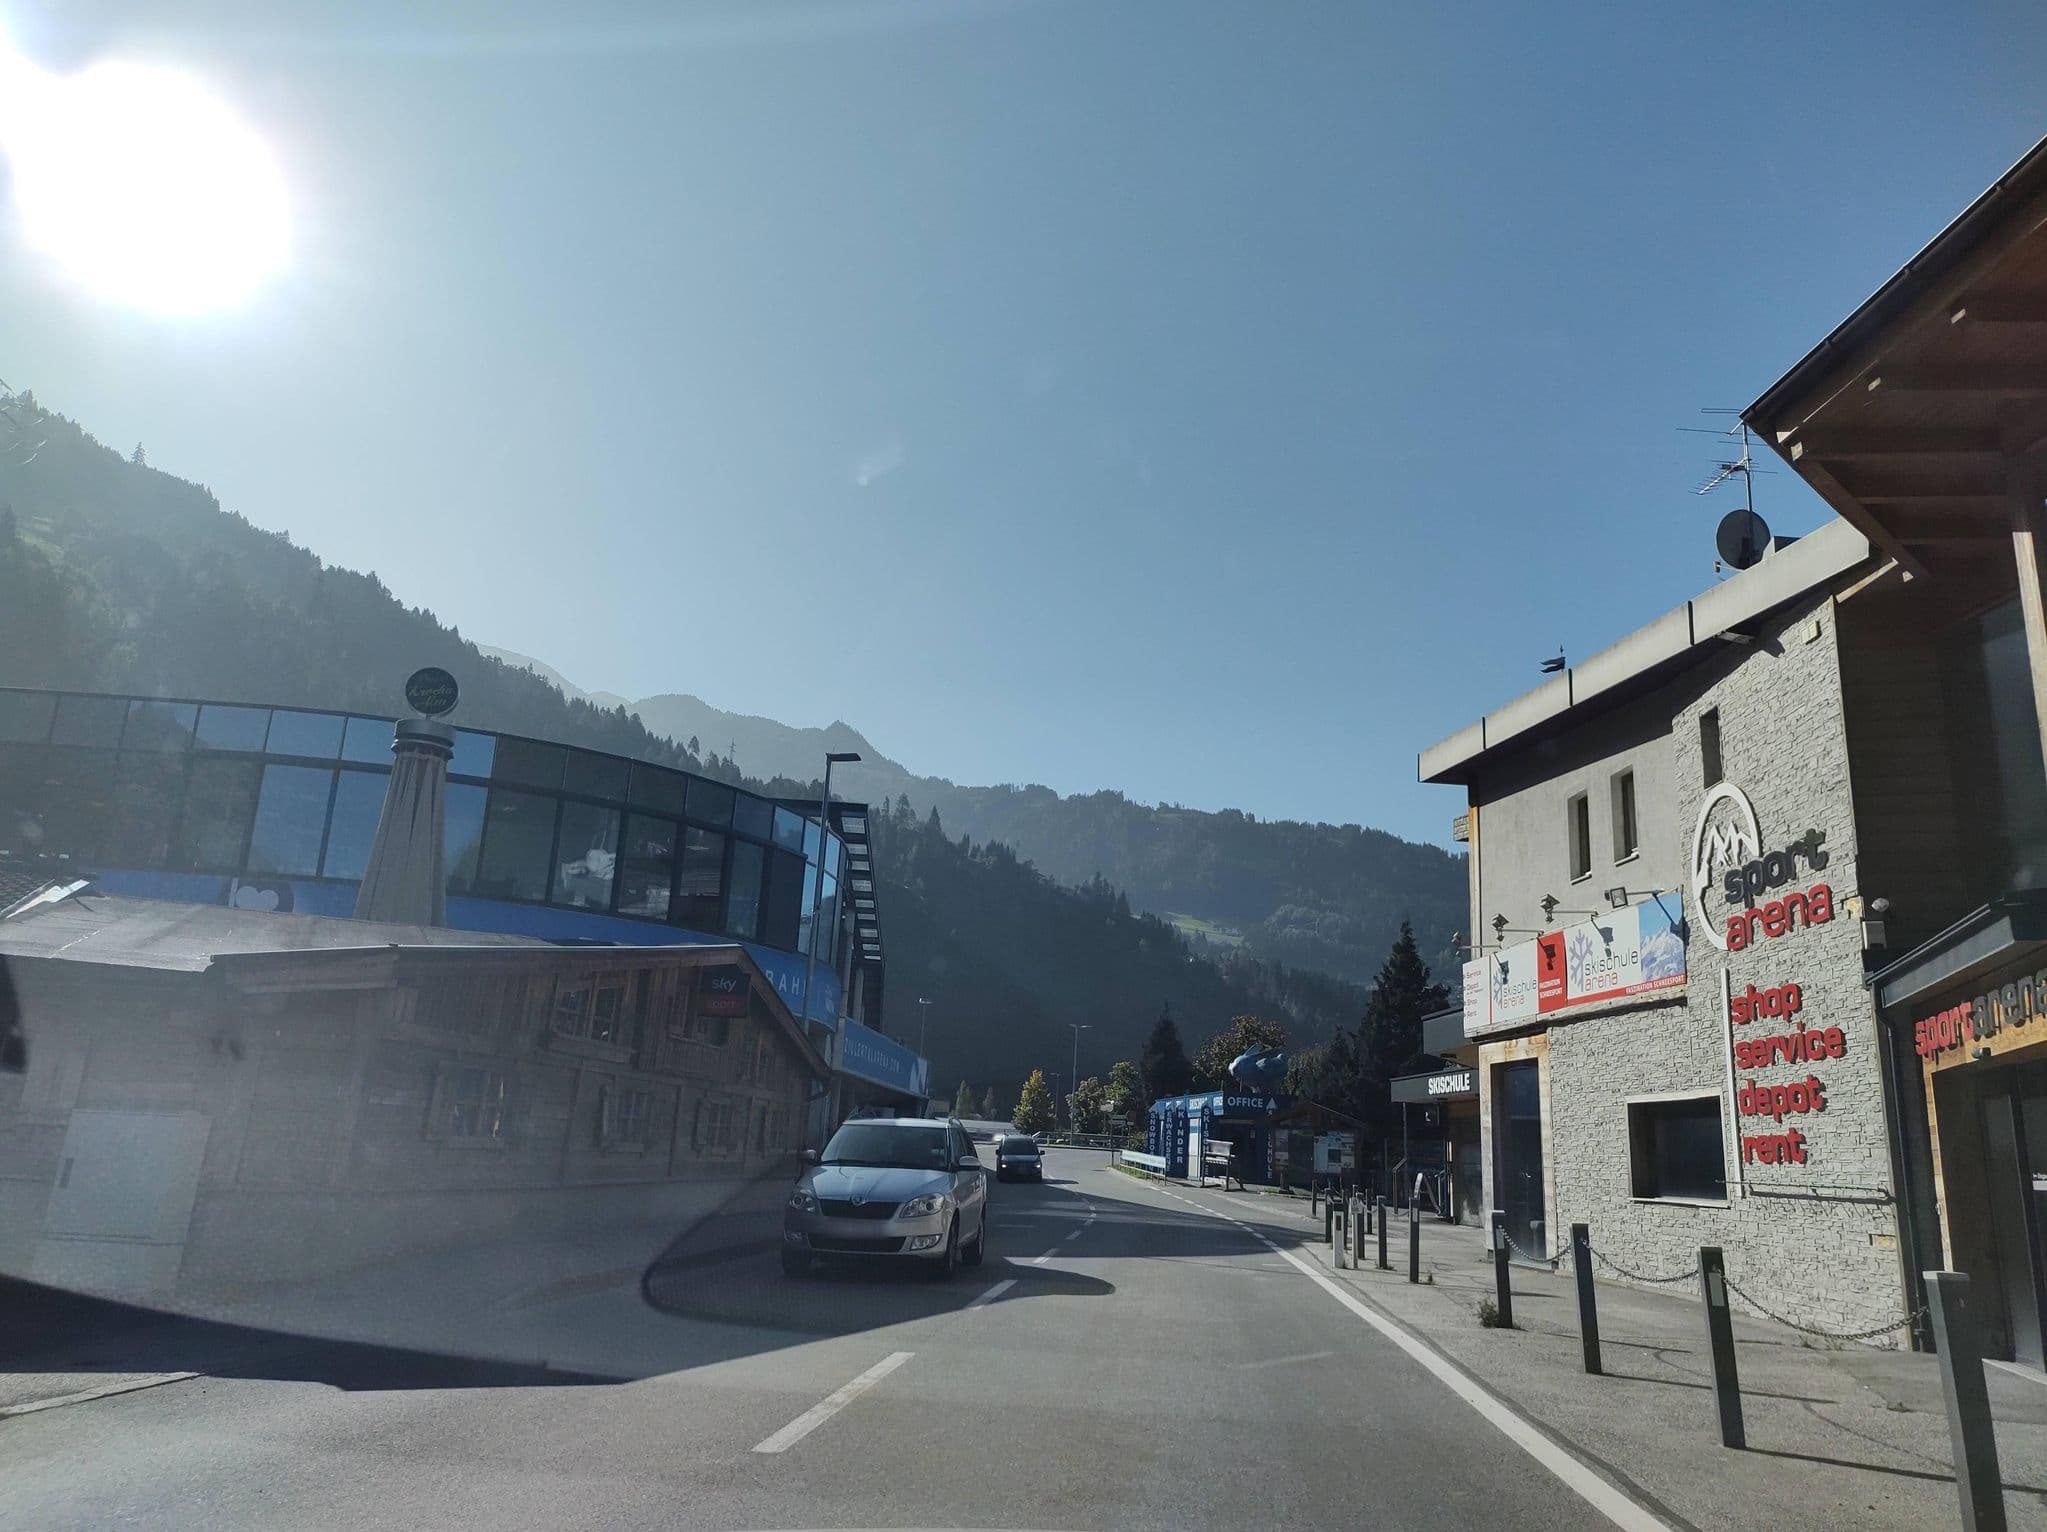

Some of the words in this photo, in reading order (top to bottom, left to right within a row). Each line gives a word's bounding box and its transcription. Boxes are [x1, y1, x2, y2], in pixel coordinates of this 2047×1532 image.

[1724, 828, 1829, 908] sport
[1727, 883, 1834, 951] arena
[1584, 950, 1638, 976] skischule
[1584, 972, 1618, 991] arena
[711, 977, 737, 992] sky
[1731, 983, 1802, 1024] shop
[1735, 1021, 1846, 1069] service
[1227, 1096, 1263, 1109] OFFICE
[1428, 1072, 1471, 1096] SKISCHULE
[1739, 1074, 1824, 1123] depot
[1177, 1110, 1185, 1164] KINDER
[1743, 1127, 1808, 1165] rent
